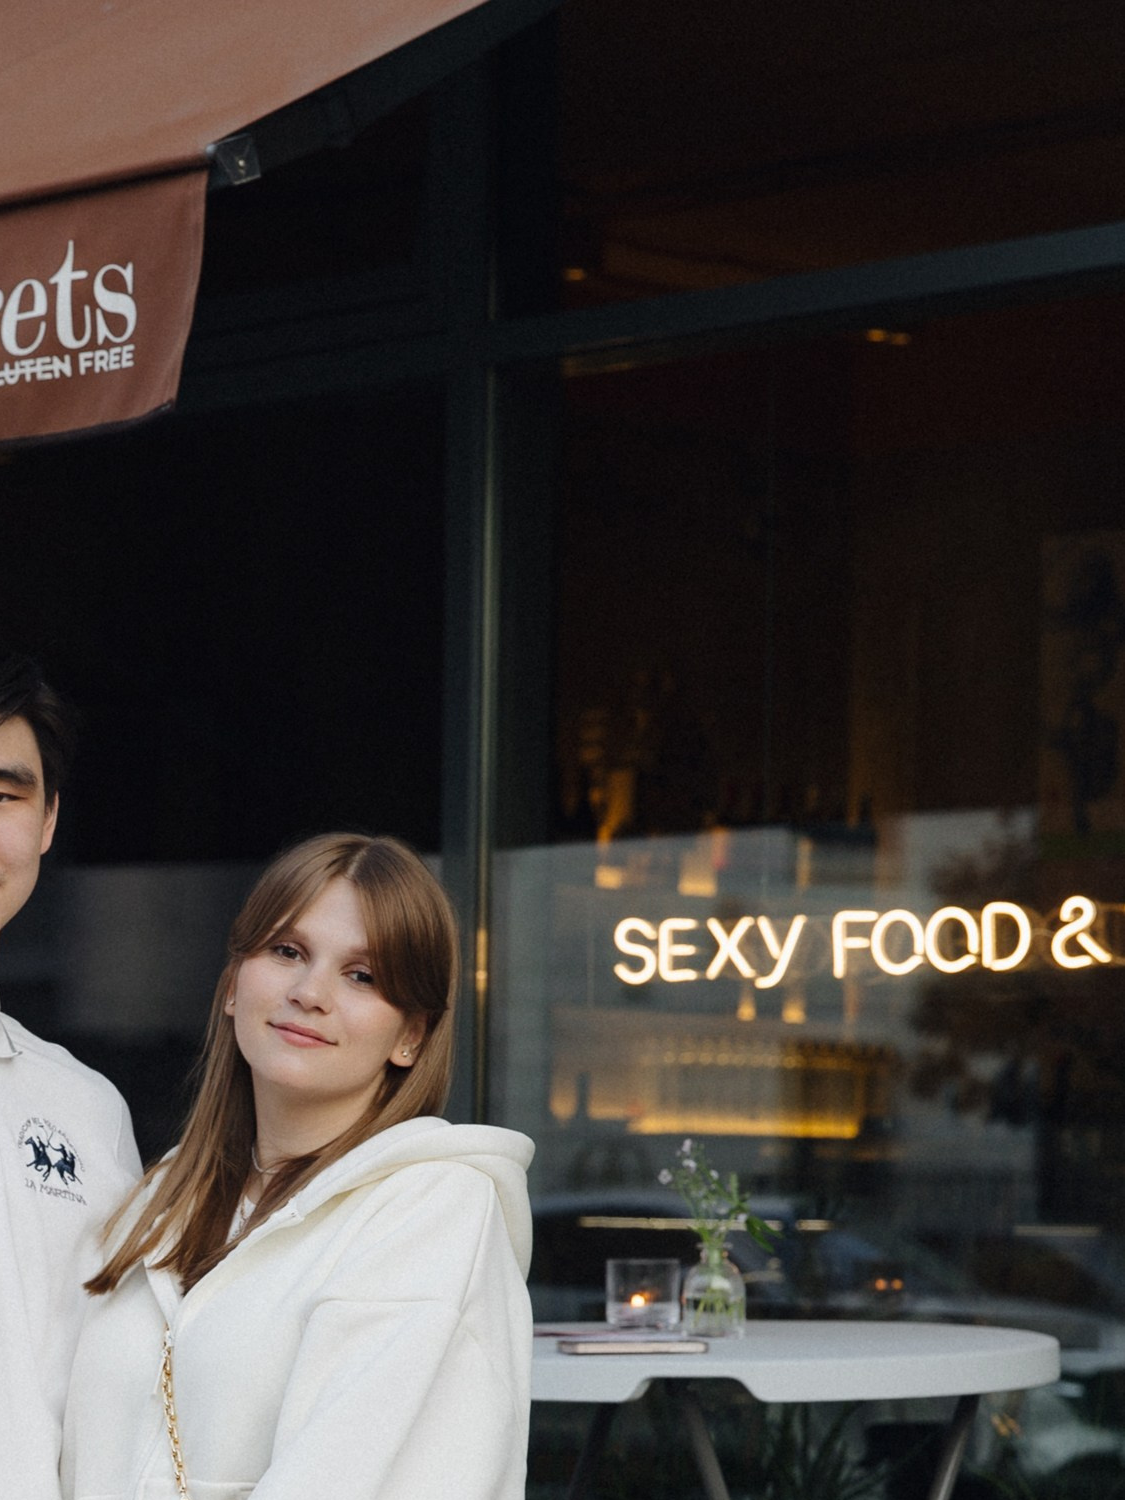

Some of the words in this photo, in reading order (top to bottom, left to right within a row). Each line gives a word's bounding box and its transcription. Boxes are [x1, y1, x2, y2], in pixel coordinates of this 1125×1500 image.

[79, 344, 135, 375] FREE
[613, 914, 807, 989] SEXY
[831, 901, 1031, 979] FOOD
[1051, 895, 1112, 969] &
